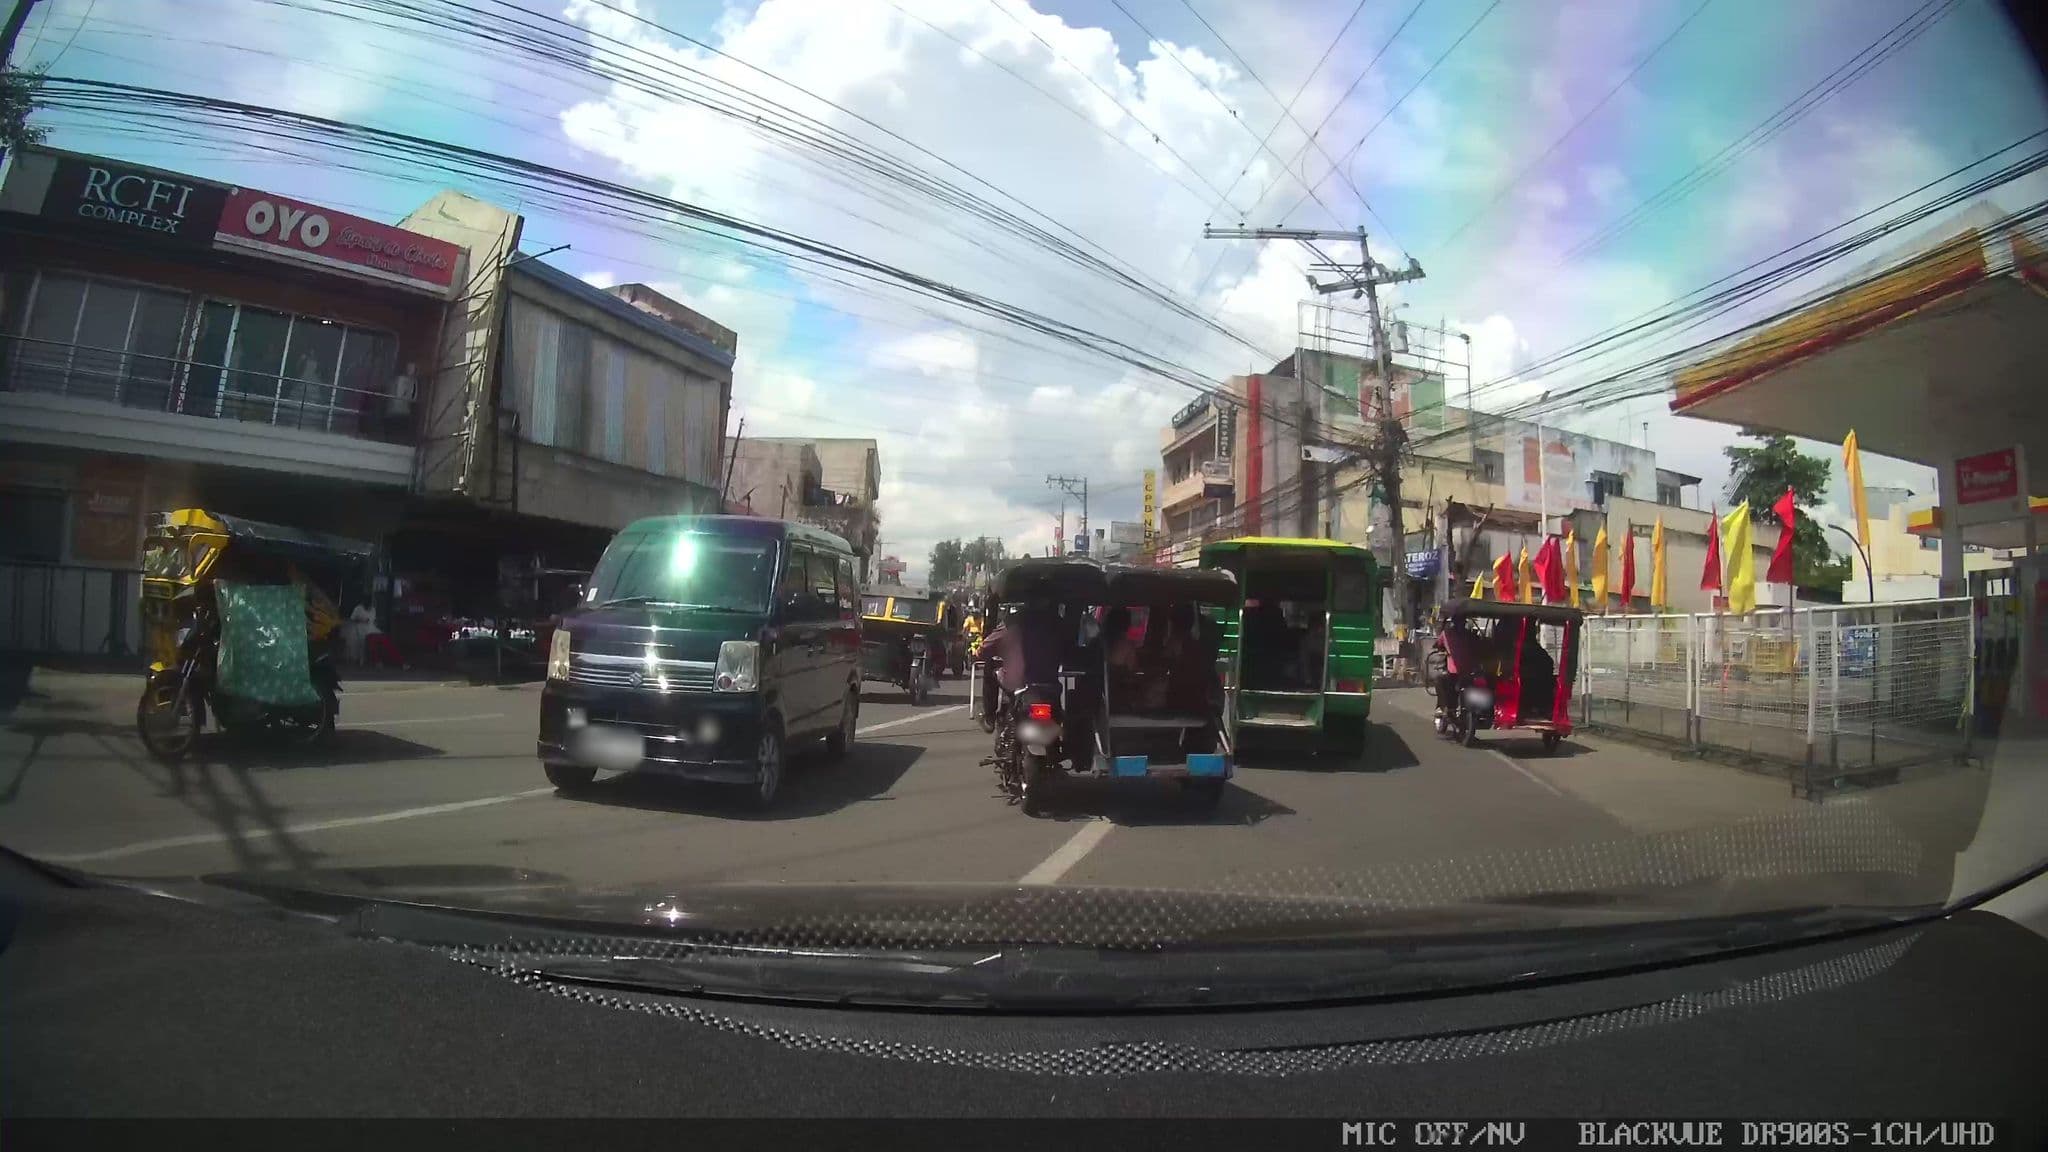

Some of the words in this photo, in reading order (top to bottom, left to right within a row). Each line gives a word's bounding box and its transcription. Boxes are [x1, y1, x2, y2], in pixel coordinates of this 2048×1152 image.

[83, 167, 194, 218] RCFI
[78, 203, 180, 234] COMPLEX
[245, 200, 330, 248] OYO
